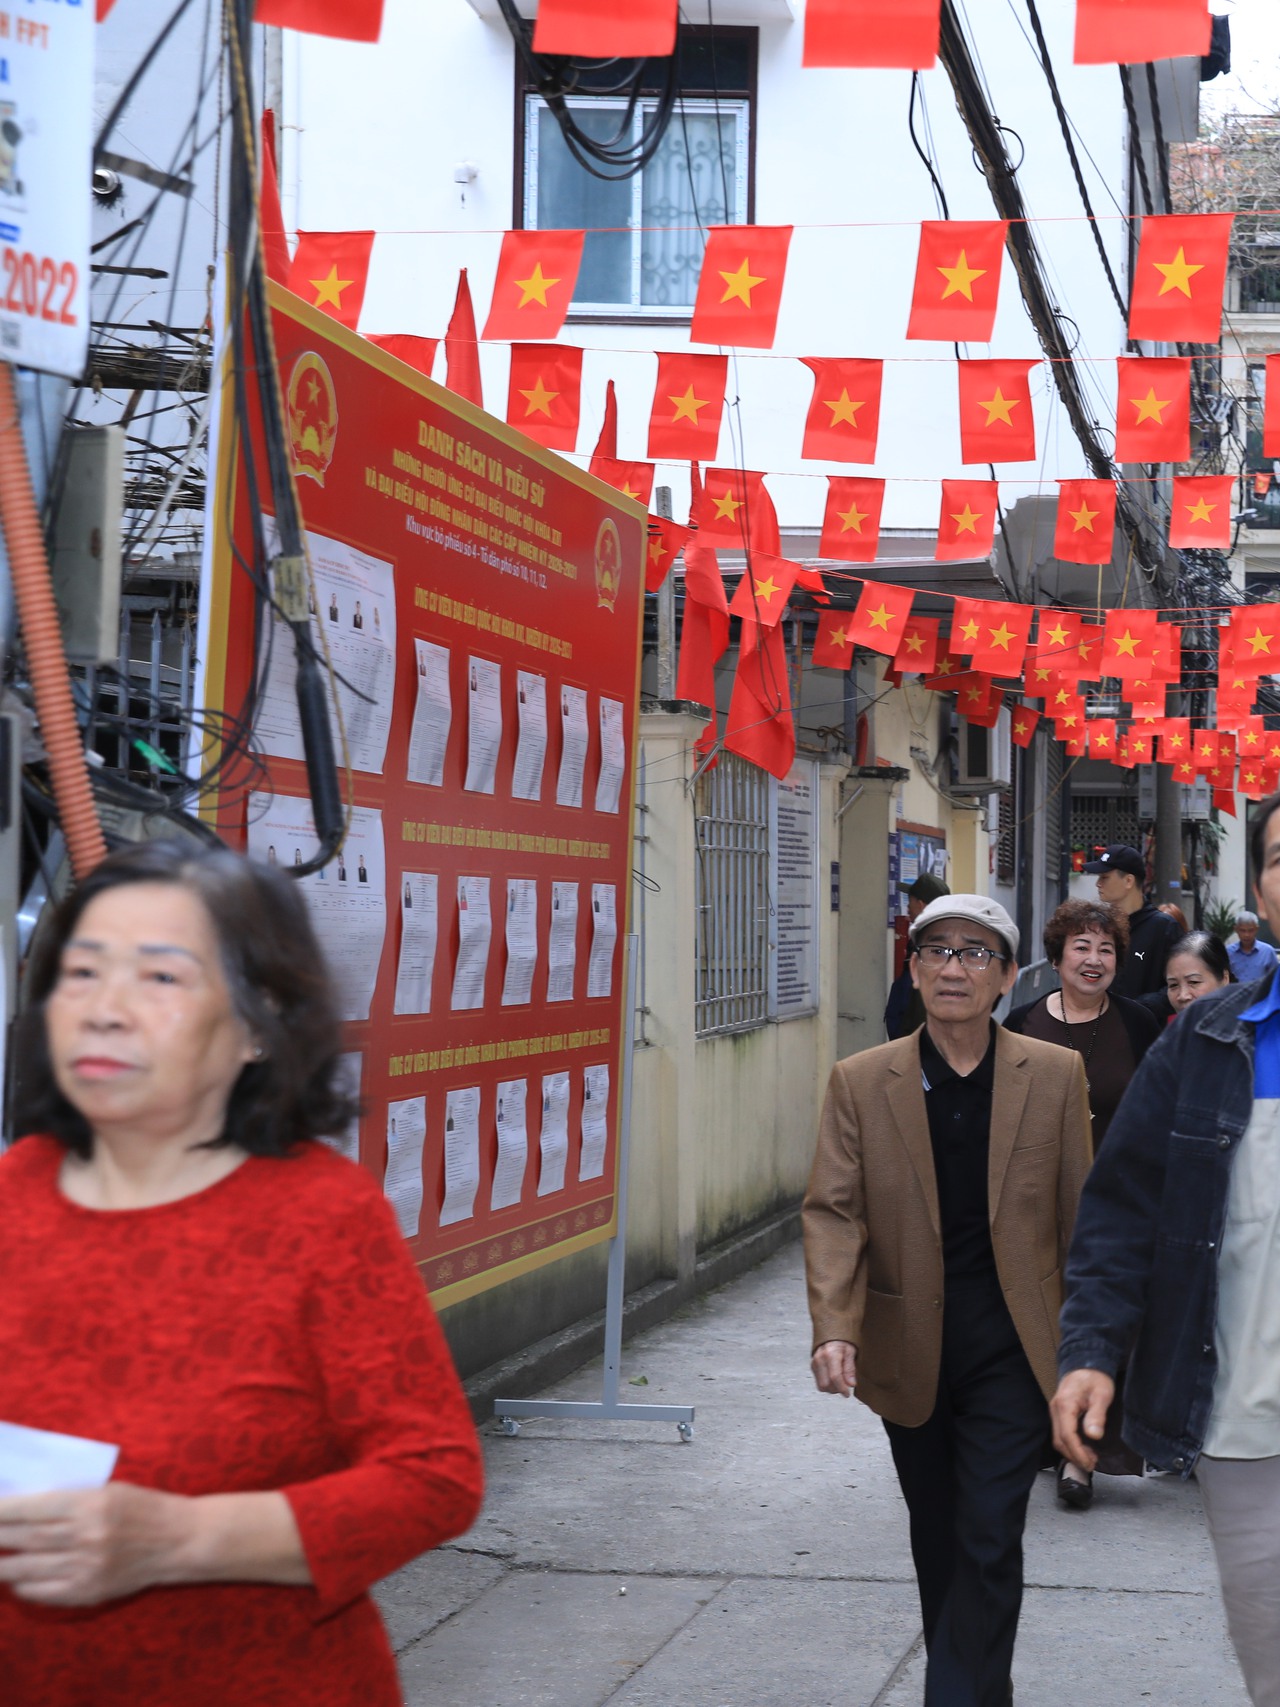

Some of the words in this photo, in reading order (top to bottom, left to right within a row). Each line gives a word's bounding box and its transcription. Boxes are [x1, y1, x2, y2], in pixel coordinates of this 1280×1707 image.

[17, 17, 49, 50] FPT
[393, 448, 422, 478] NHỮNG
[422, 463, 447, 490] NGƯỜI
[447, 473, 463, 499] ỨNG
[464, 482, 476, 504] CỬ
[418, 419, 455, 461] DANH
[456, 441, 486, 478] SÁCH
[488, 457, 503, 487] VÀ
[505, 464, 530, 500] TIỂU
[530, 479, 546, 508] SỬ
[365, 466, 377, 489] VÀ
[378, 473, 394, 499] ĐẠI
[394, 479, 414, 505] BIỂU
[414, 490, 429, 515] HỘI
[429, 495, 451, 523] ĐỒNG
[451, 508, 473, 532] NHÂN
[473, 517, 489, 540] DÂN
[489, 525, 503, 546] CÁC
[503, 530, 517, 552] CẤP
[517, 539, 539, 563] NHIỆM
[405, 514, 420, 536] Khu
[421, 526, 434, 544] vực
[434, 526, 445, 544] bỏ
[444, 532, 464, 554] phiếu
[463, 539, 472, 557] số
[472, 544, 477, 559] 4
[480, 545, 489, 564] Tổ
[488, 550, 501, 569] dân
[501, 556, 513, 574] phố
[512, 560, 520, 577] số
